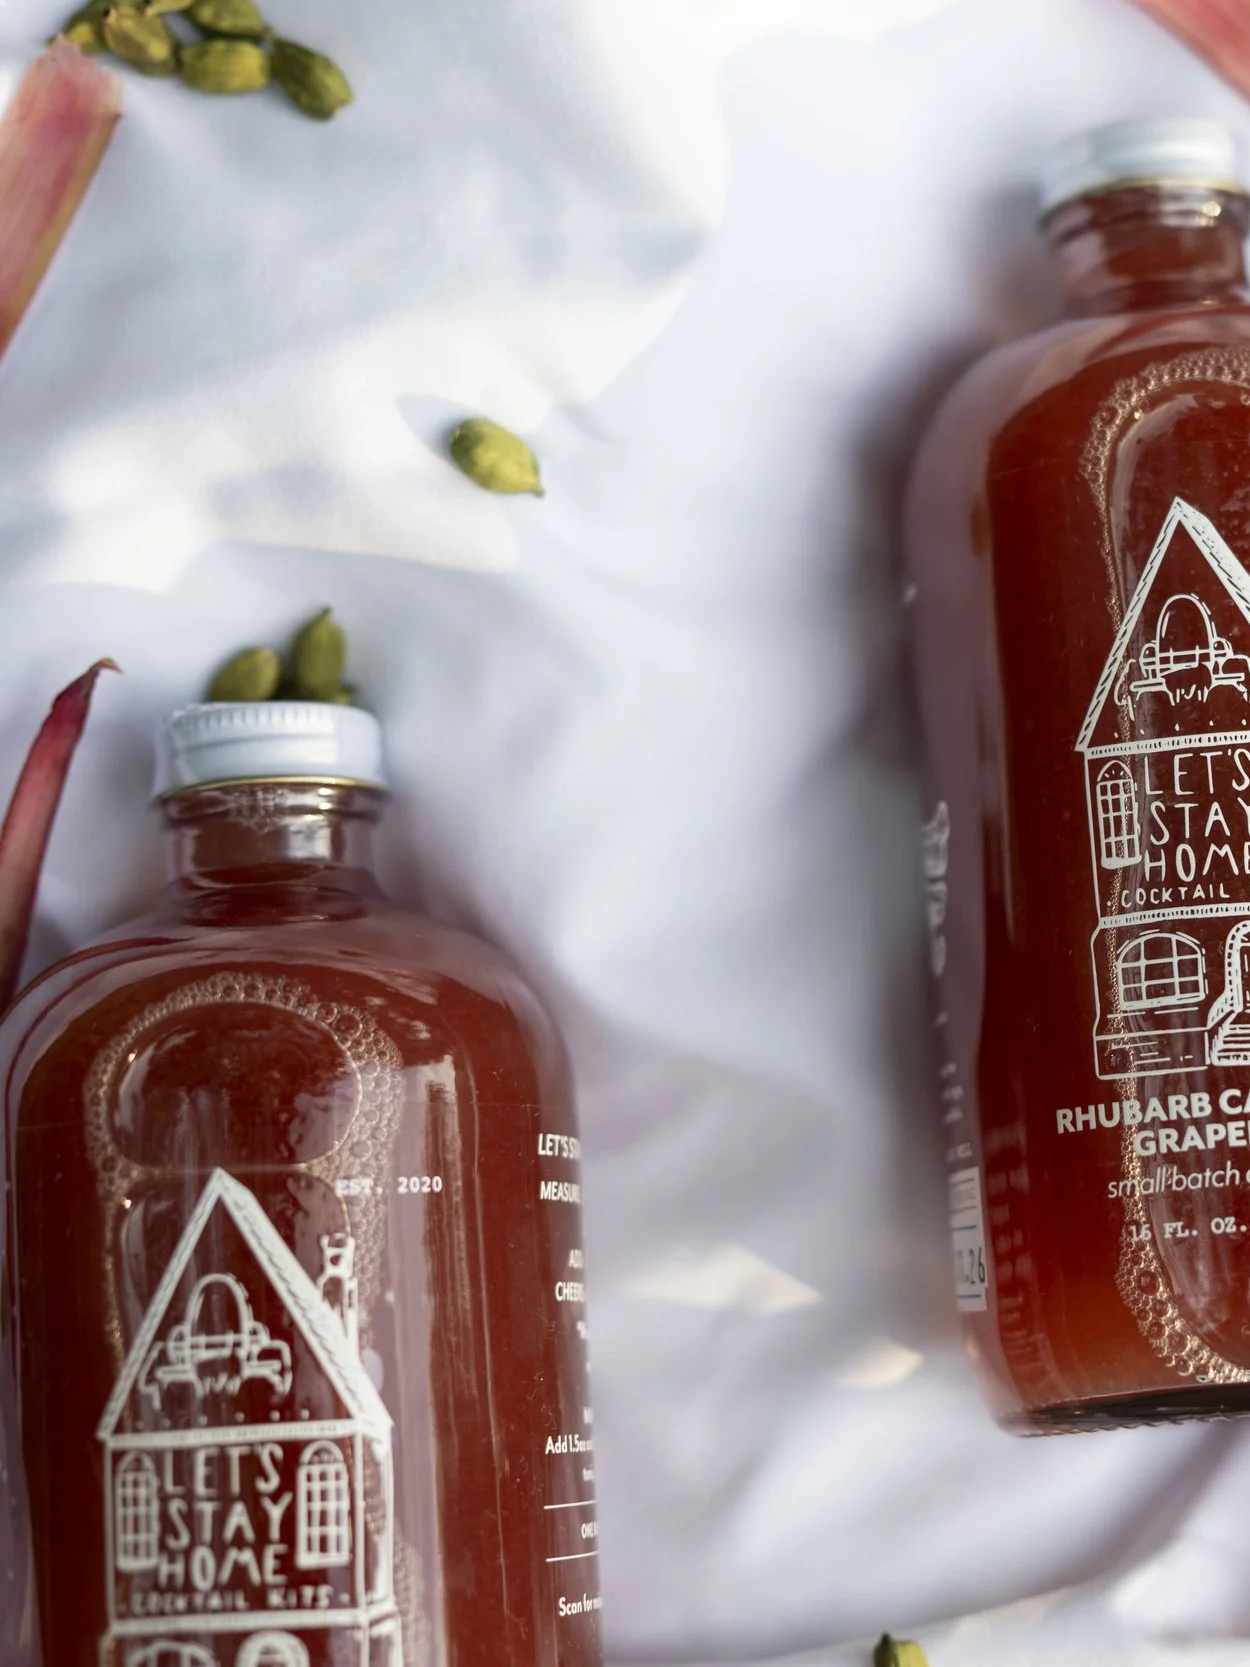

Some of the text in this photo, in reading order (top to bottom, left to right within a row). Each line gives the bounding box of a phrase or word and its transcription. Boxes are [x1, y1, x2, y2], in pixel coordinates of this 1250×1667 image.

[1144, 748, 1250, 795] LET'S
[1121, 883, 1230, 907] COCKTAIL
[1056, 1092, 1211, 1134] RHUBARB
[335, 1176, 442, 1197] EST. 2020
[1107, 1164, 1166, 1199] small
[1172, 1160, 1240, 1191] batch
[1130, 1223, 1151, 1243] 16
[1163, 1221, 1198, 1240] FL.
[1210, 1216, 1247, 1235] OZ.
[545, 1435, 568, 1454] Add
[163, 1443, 284, 1497] LET'S
[165, 1491, 293, 1550] STAY
[158, 1543, 288, 1591] HOME
[266, 1584, 334, 1609] KITS
[558, 1597, 583, 1616] Scan
